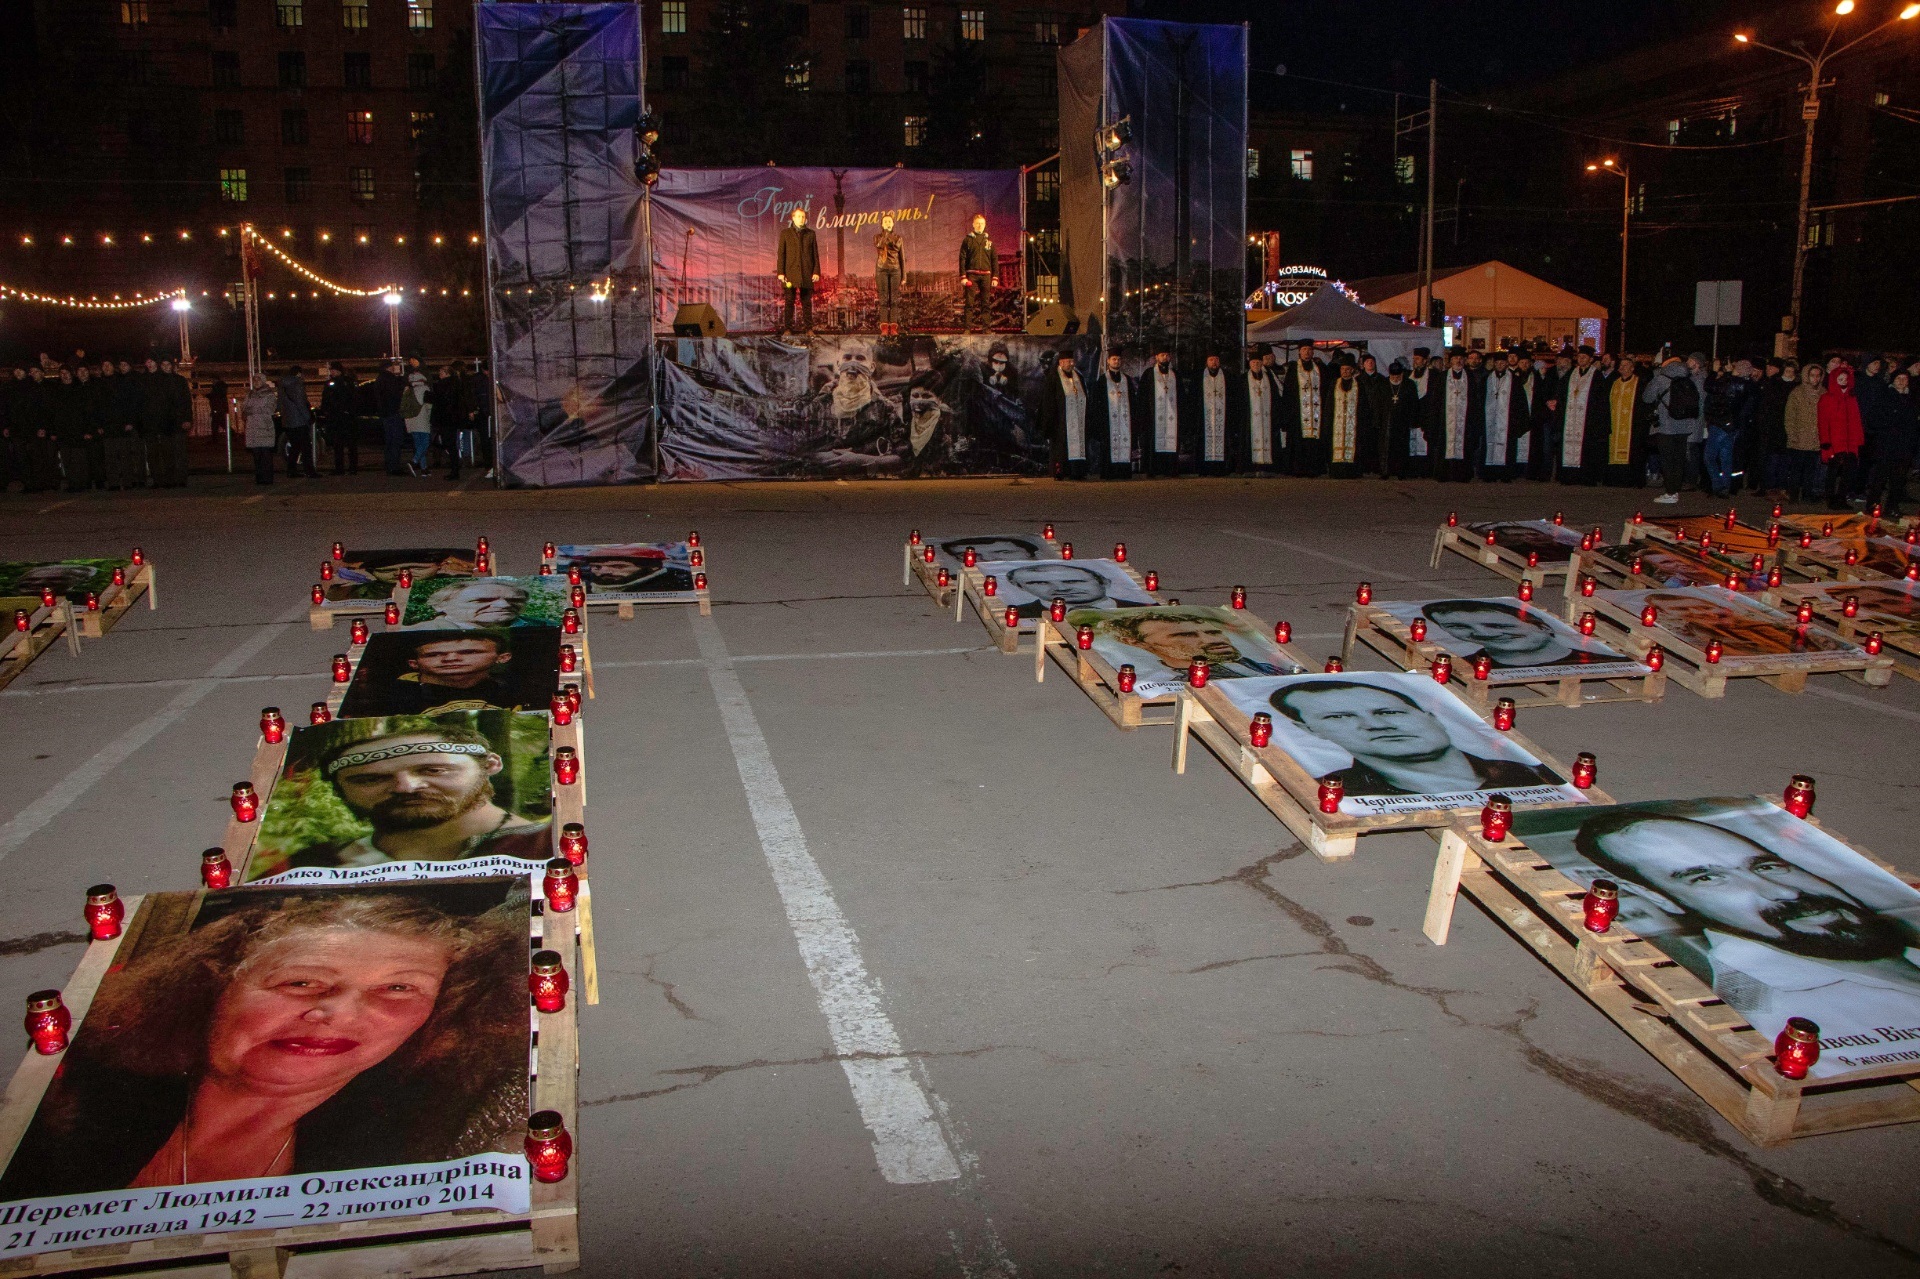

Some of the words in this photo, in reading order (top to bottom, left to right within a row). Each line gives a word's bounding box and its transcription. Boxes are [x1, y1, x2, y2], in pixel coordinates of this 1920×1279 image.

[737, 187, 814, 223] Герої
[1279, 265, 1327, 278] КОВЗАНКА
[1354, 796, 1422, 807] Чернець
[1422, 791, 1474, 804] Віктор
[1372, 807, 1387, 815] 27
[329, 864, 407, 880] Максим
[413, 857, 546, 874] Миколайович
[1872, 1026, 1920, 1042] Вік
[1838, 1055, 1856, 1067] 8
[1855, 1050, 1920, 1066] жовтня
[0, 1198, 138, 1226] Шеремет
[143, 1184, 290, 1211] Людмила
[300, 1161, 522, 1196] Олександрівна
[4, 1230, 37, 1250] 21
[43, 1219, 189, 1245] листопада
[199, 1208, 257, 1229] 1942
[301, 1202, 330, 1219] 22
[337, 1194, 431, 1215] лютого
[438, 1183, 495, 1204] 2014
